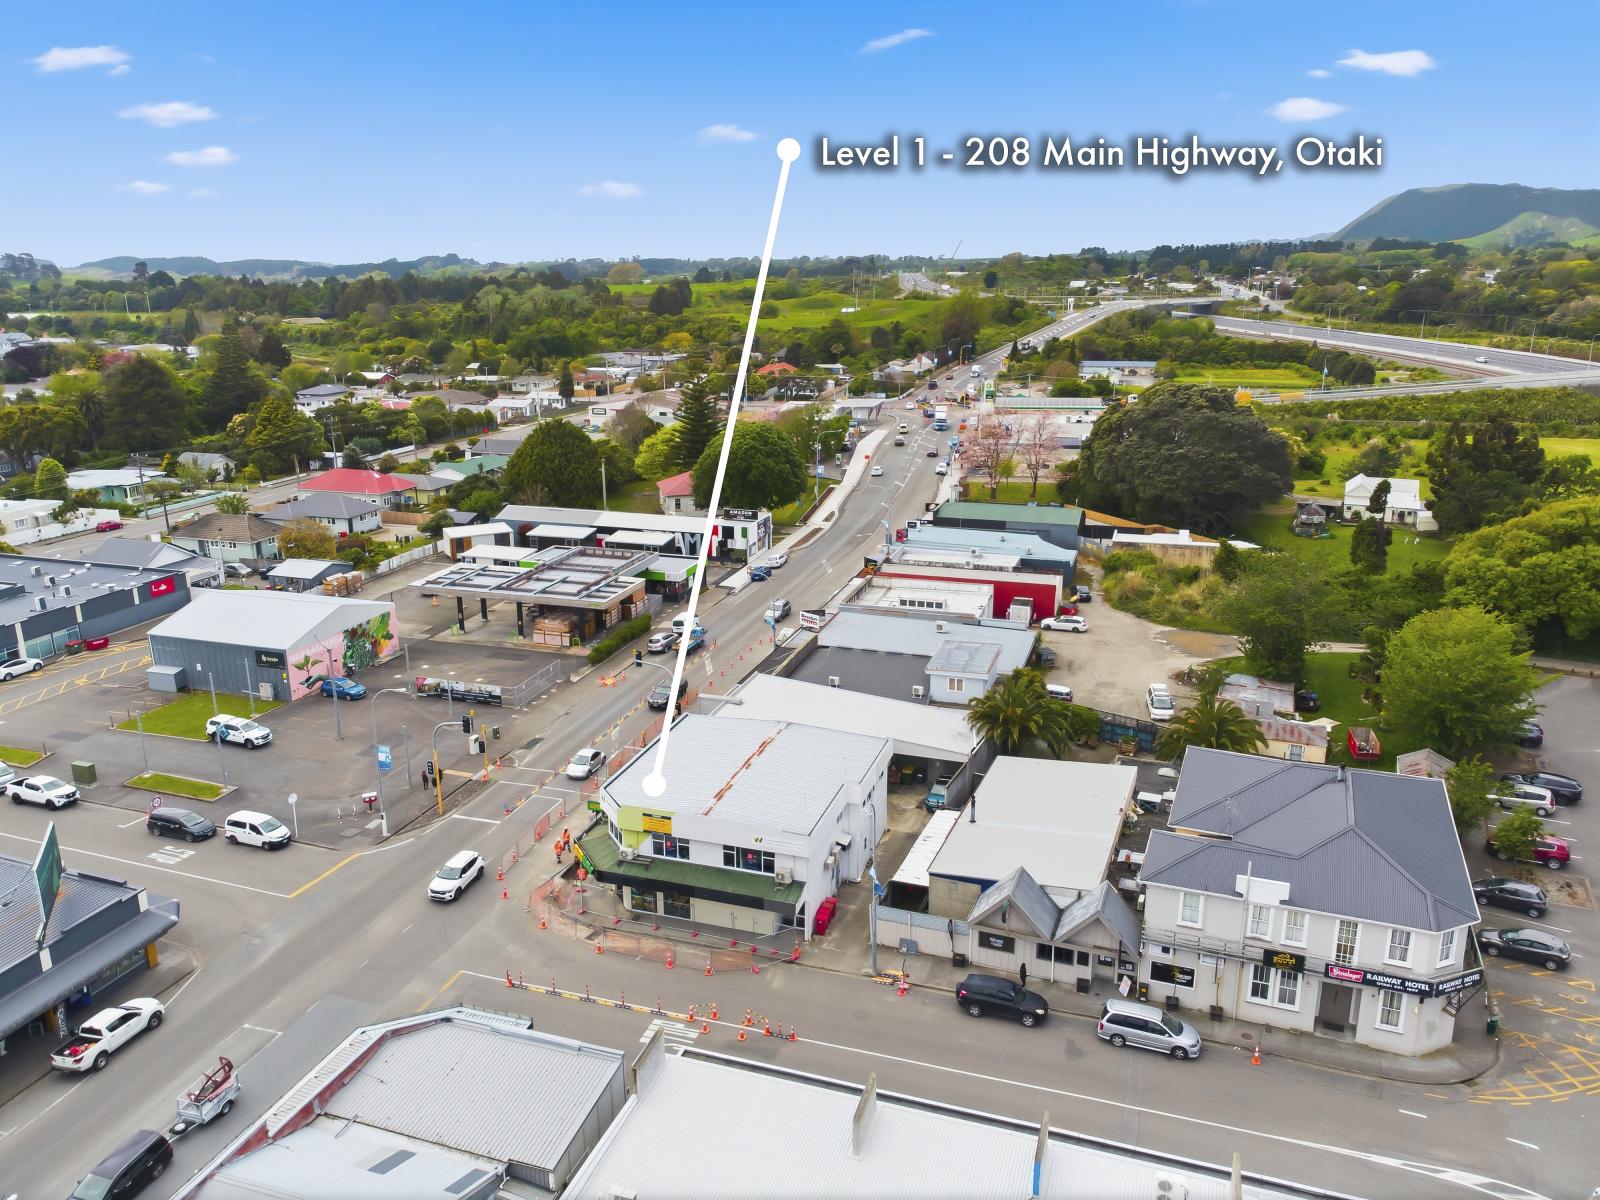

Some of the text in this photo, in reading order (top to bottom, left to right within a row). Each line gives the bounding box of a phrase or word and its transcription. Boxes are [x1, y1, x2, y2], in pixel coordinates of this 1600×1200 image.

[1366, 973, 1430, 991] RAILWAY HOTEL
[1438, 973, 1480, 991] RAILWAY HOTEL
